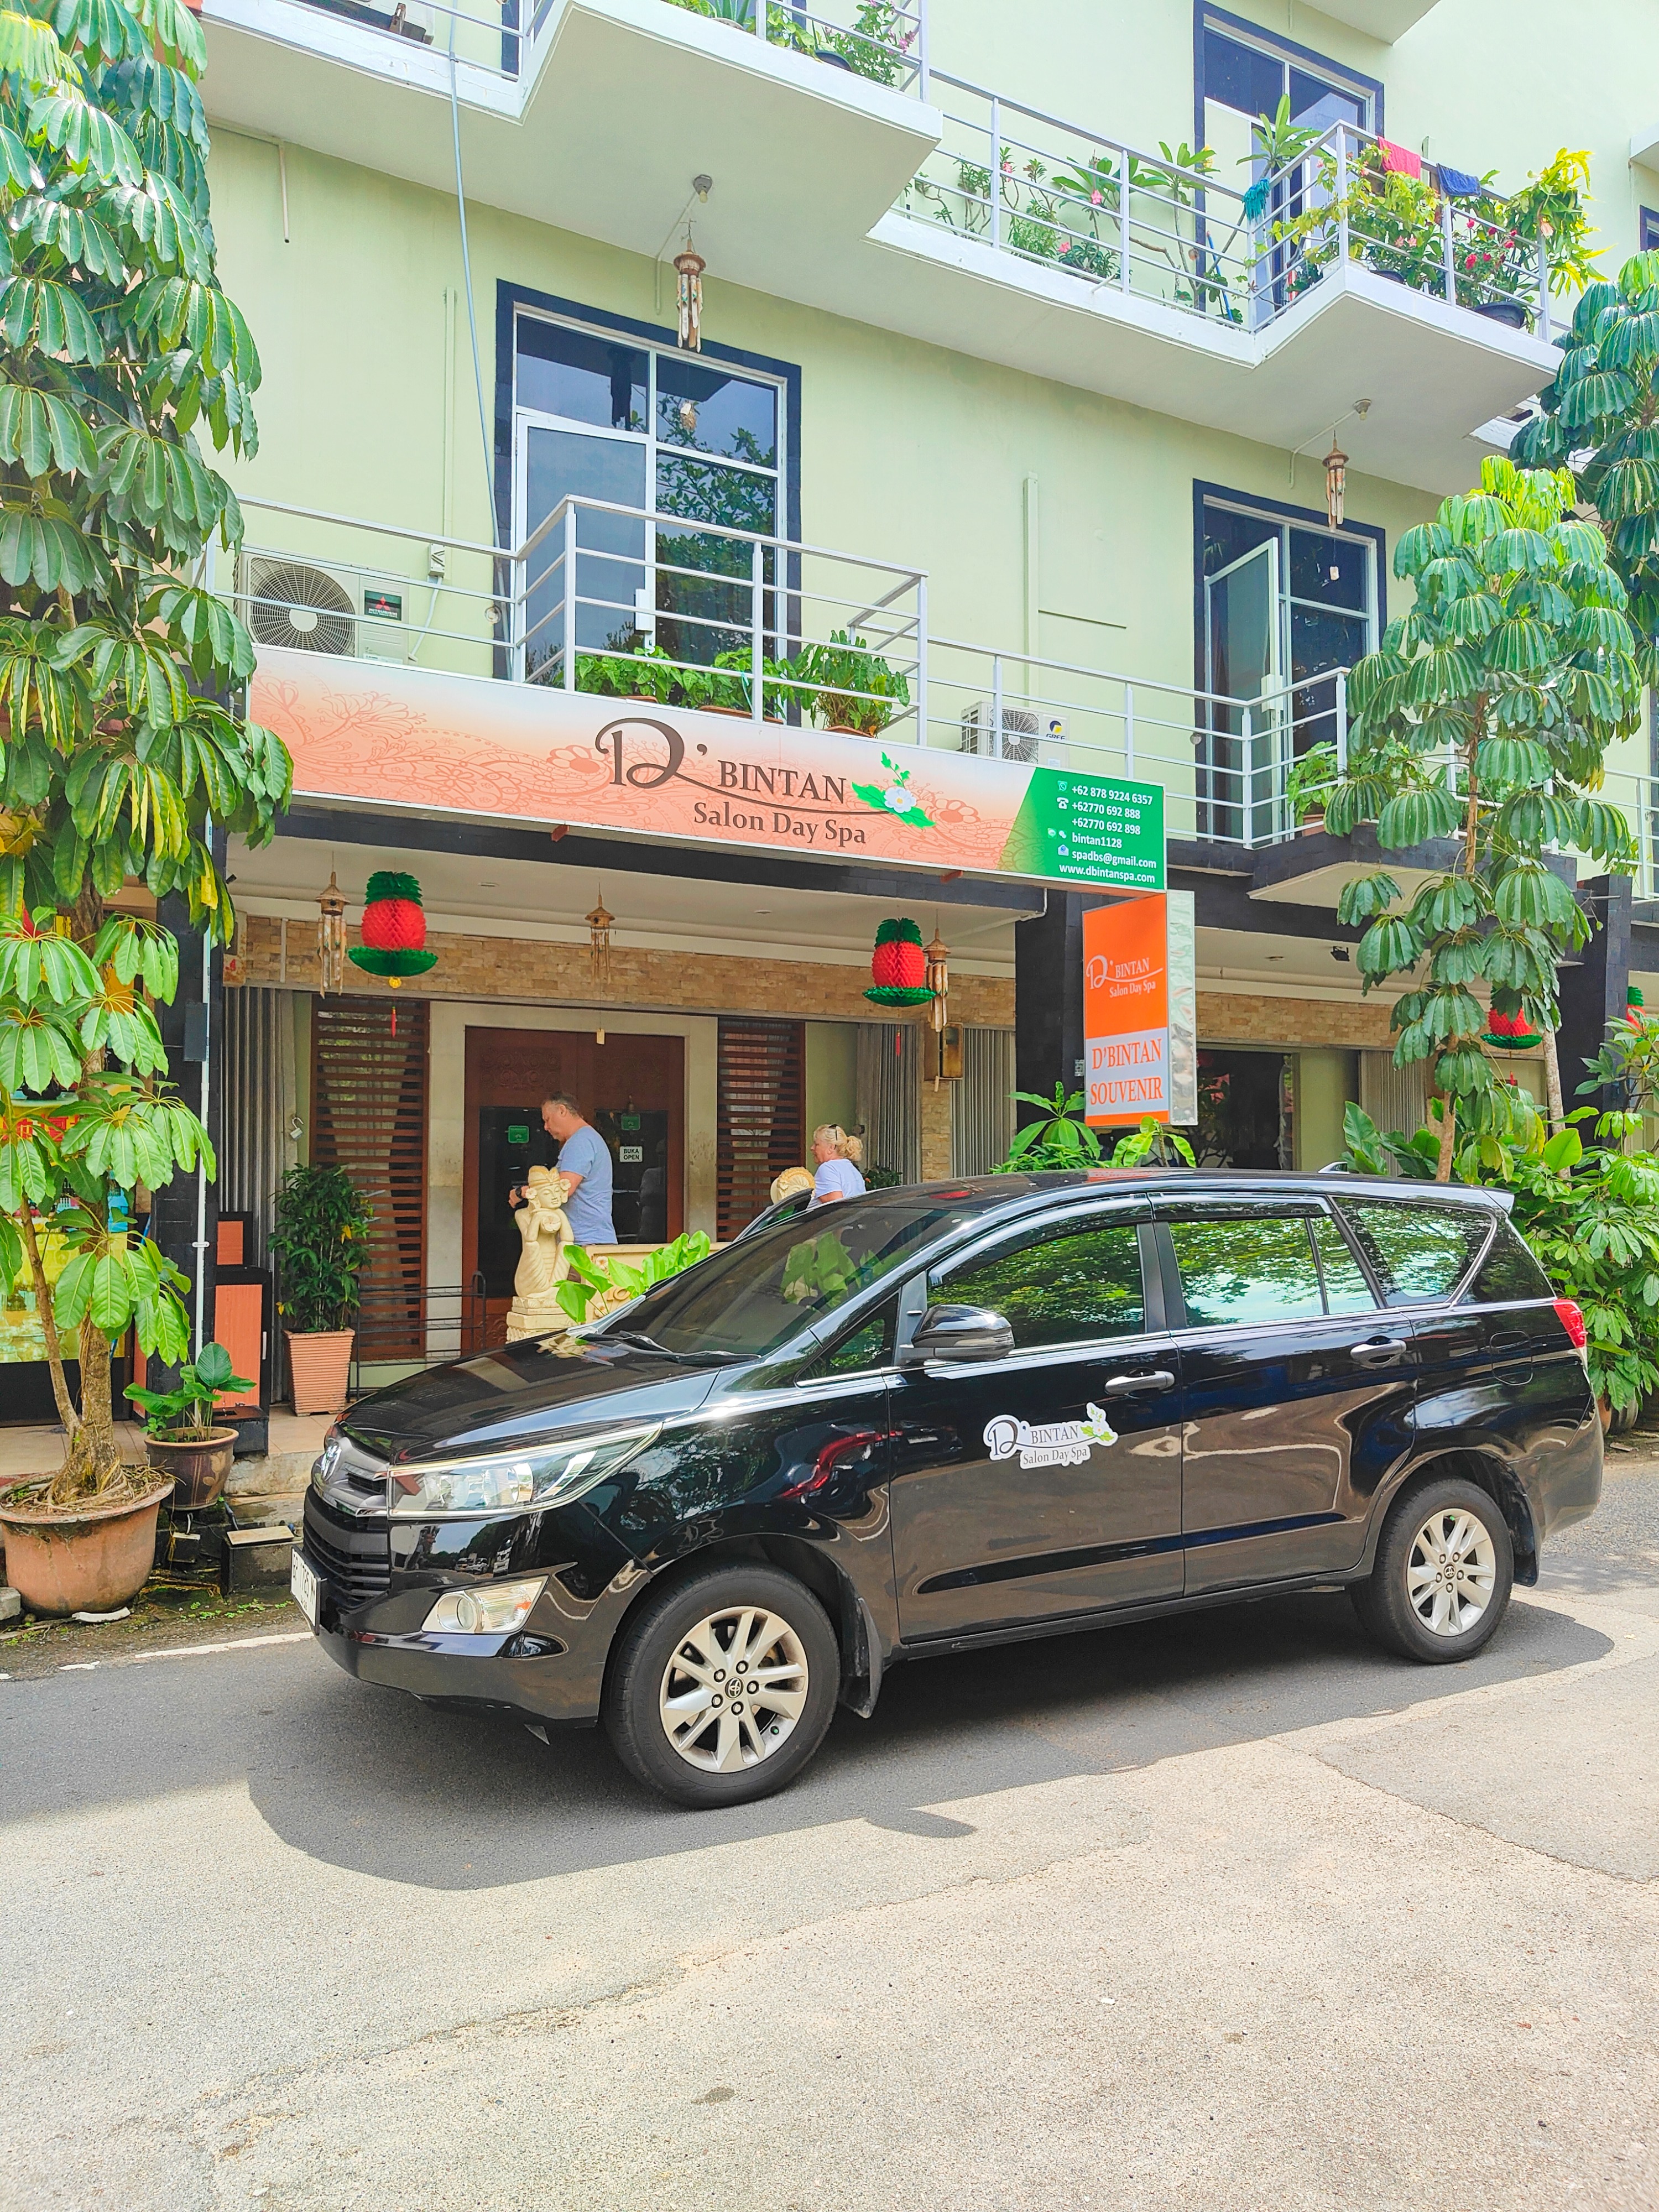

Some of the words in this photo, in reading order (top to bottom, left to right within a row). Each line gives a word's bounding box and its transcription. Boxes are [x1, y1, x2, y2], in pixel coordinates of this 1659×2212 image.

[718, 760, 847, 804] BINTAN
[1072, 785, 1088, 796] +62
[1090, 787, 1107, 799] 878
[1108, 789, 1130, 802] 9224
[1131, 793, 1153, 805] 6357
[1072, 801, 1105, 815] +62770
[1107, 805, 1123, 817] 692
[1124, 807, 1141, 819] 888
[694, 801, 765, 831] Salon
[773, 812, 820, 844] Day
[825, 820, 866, 848] Spa
[1072, 817, 1105, 830] +62770
[1107, 821, 1123, 833] 692
[1124, 823, 1141, 835] 898
[1072, 832, 1123, 848] bintan1128
[1072, 850, 1157, 869] spadbs@gmail.com
[1058, 864, 1155, 883] www.dbintanspa.com
[1115, 957, 1150, 978] BINTAN
[1109, 983, 1128, 998] Salon
[1129, 982, 1142, 995] Day
[1143, 979, 1156, 994] Spa
[1092, 1039, 1162, 1070] D'BINTAN
[1090, 1077, 1164, 1105] SOUVENIR
[1030, 1425, 1079, 1444] BINTAN
[1023, 1450, 1050, 1465] Salon
[1052, 1449, 1070, 1462] Day
[1071, 1447, 1087, 1460] Spa
